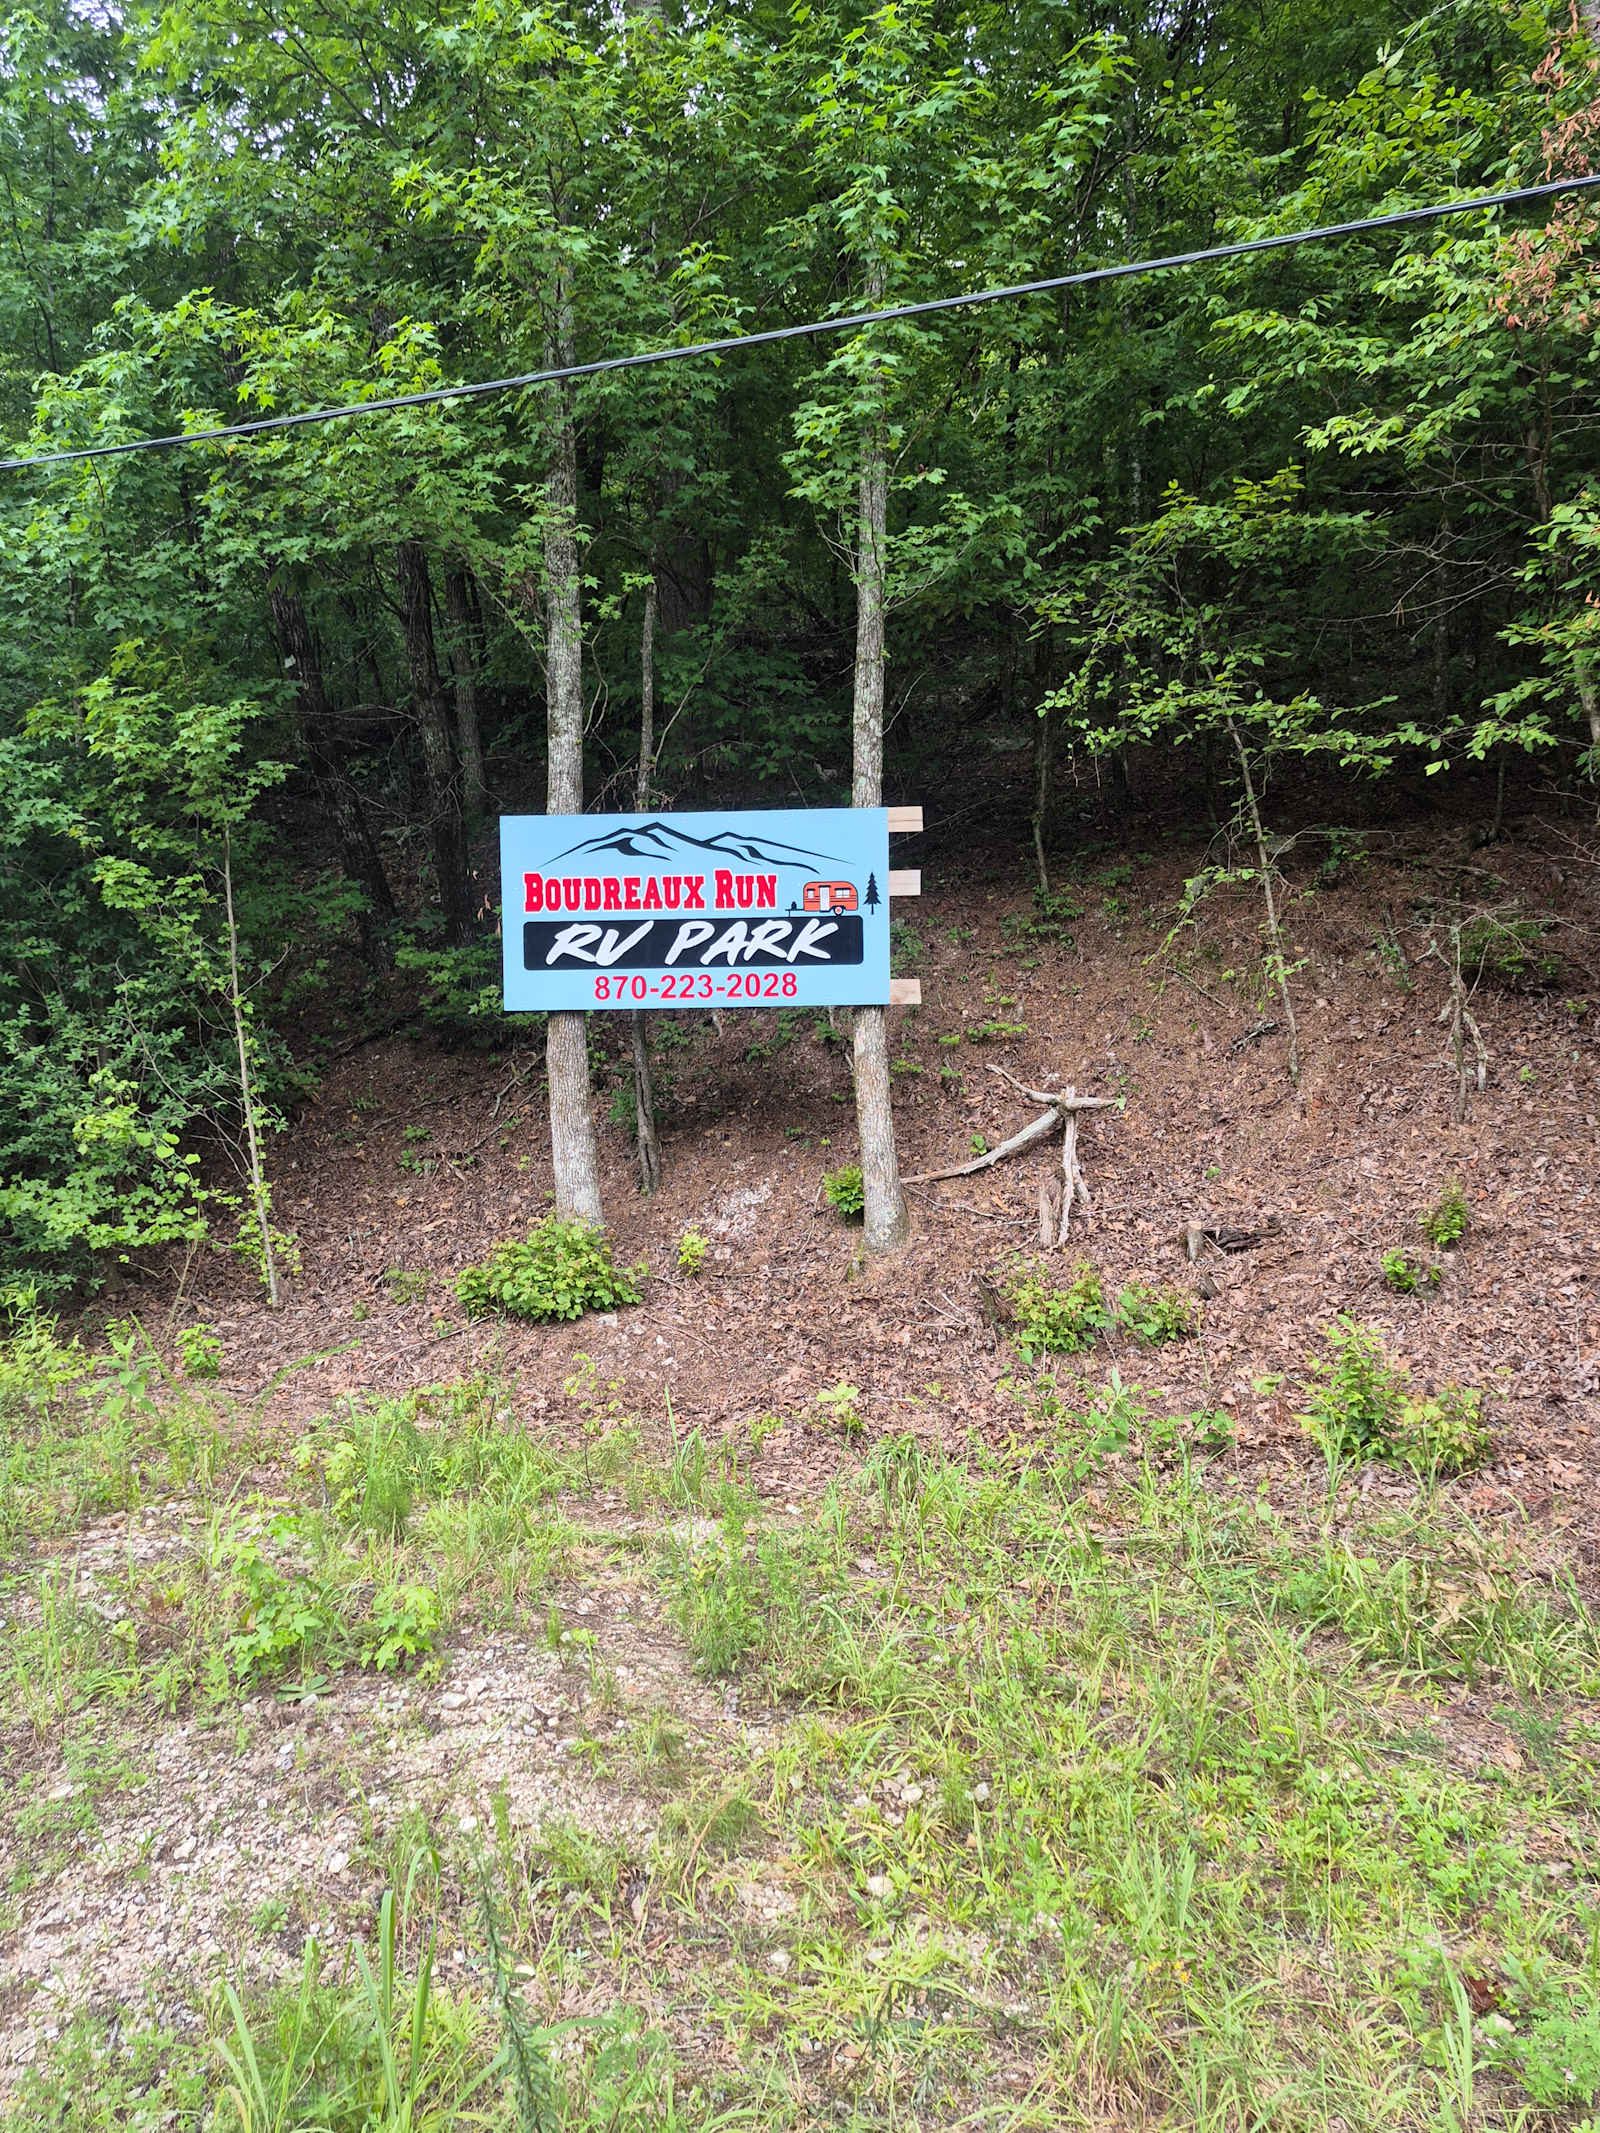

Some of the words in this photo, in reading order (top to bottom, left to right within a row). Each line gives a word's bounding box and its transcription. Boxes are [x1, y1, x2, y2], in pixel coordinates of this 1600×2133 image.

[523, 872, 705, 912] BOUDREAUX
[714, 869, 777, 908] RUN
[545, 920, 655, 966] RV
[664, 918, 839, 966] PARK
[594, 972, 798, 1000] 870-223-2028
